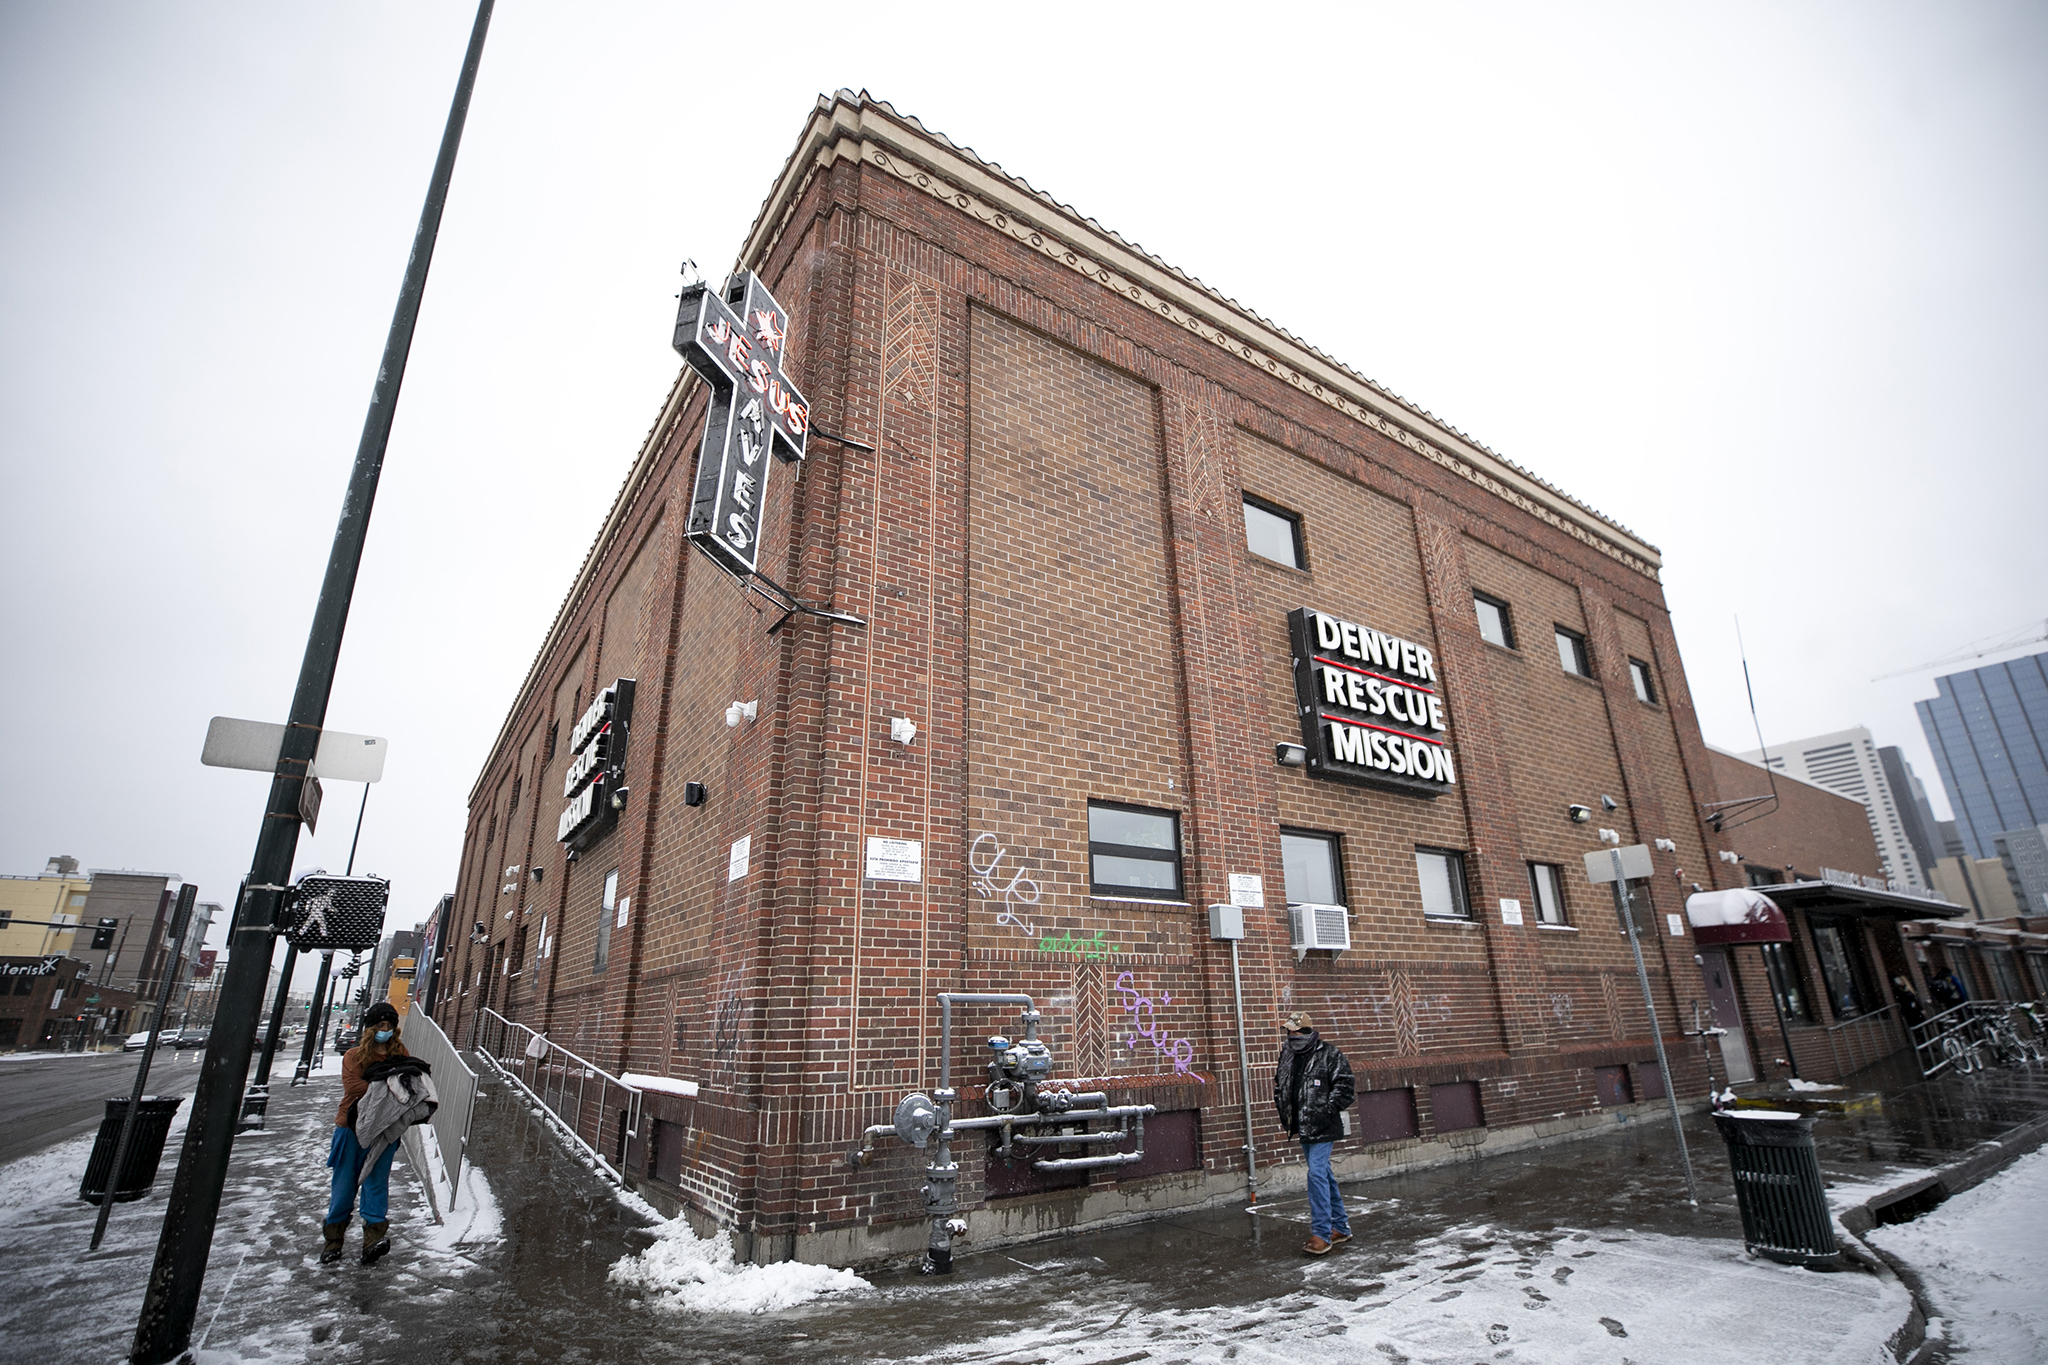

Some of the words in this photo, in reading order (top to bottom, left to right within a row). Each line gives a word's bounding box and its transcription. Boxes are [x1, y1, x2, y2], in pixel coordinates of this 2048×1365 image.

[704, 314, 809, 436] JESUS
[1315, 612, 1438, 683] DENVER
[1322, 665, 1447, 732] RESCUE
[1330, 721, 1456, 785] MISSION
[0, 962, 45, 976] terisk
